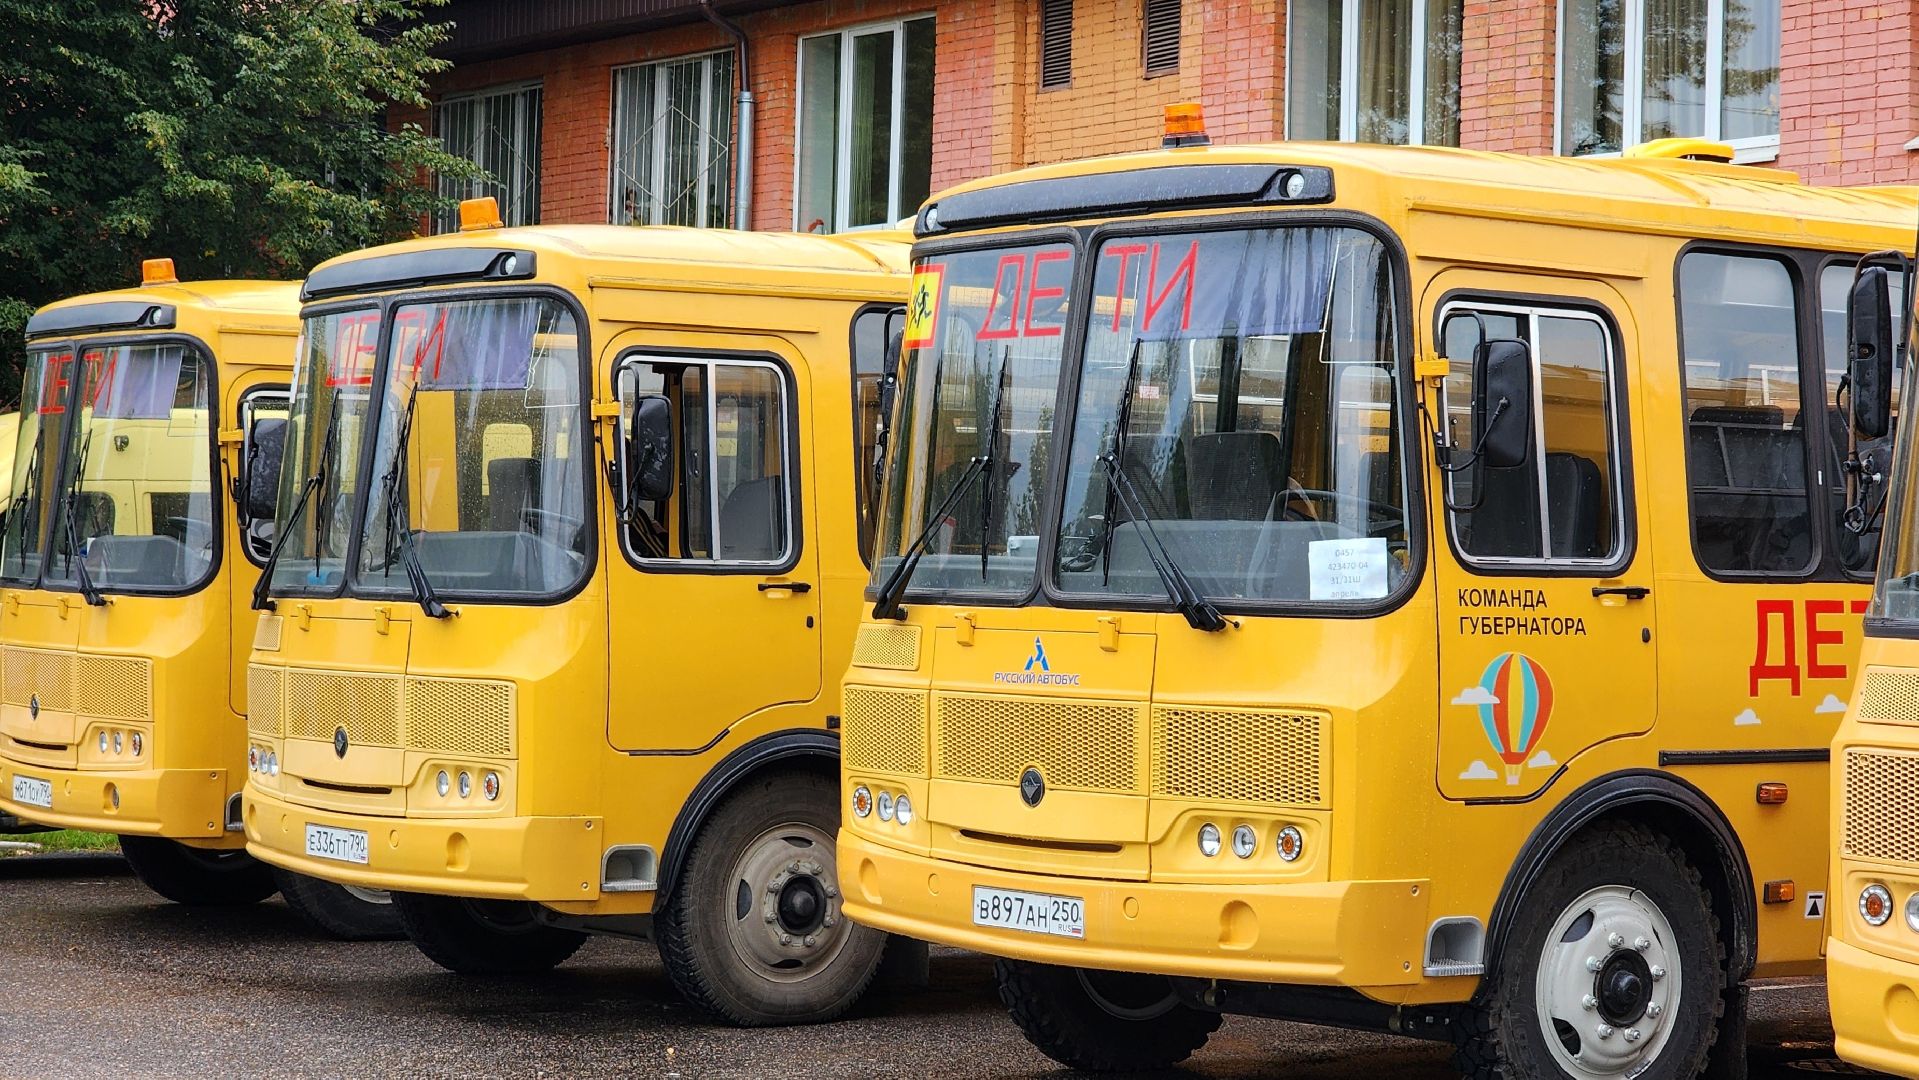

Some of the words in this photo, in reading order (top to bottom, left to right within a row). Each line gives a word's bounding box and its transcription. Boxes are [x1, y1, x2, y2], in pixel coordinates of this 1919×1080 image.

[1458, 588, 1547, 611] КОМАНДА
[1459, 616, 1587, 636] ГУБЕРНАТОРА
[1749, 599, 1871, 697] ДЕ
[994, 672, 1036, 684] РУССКИЙ
[1037, 674, 1080, 685] АВТОБУС
